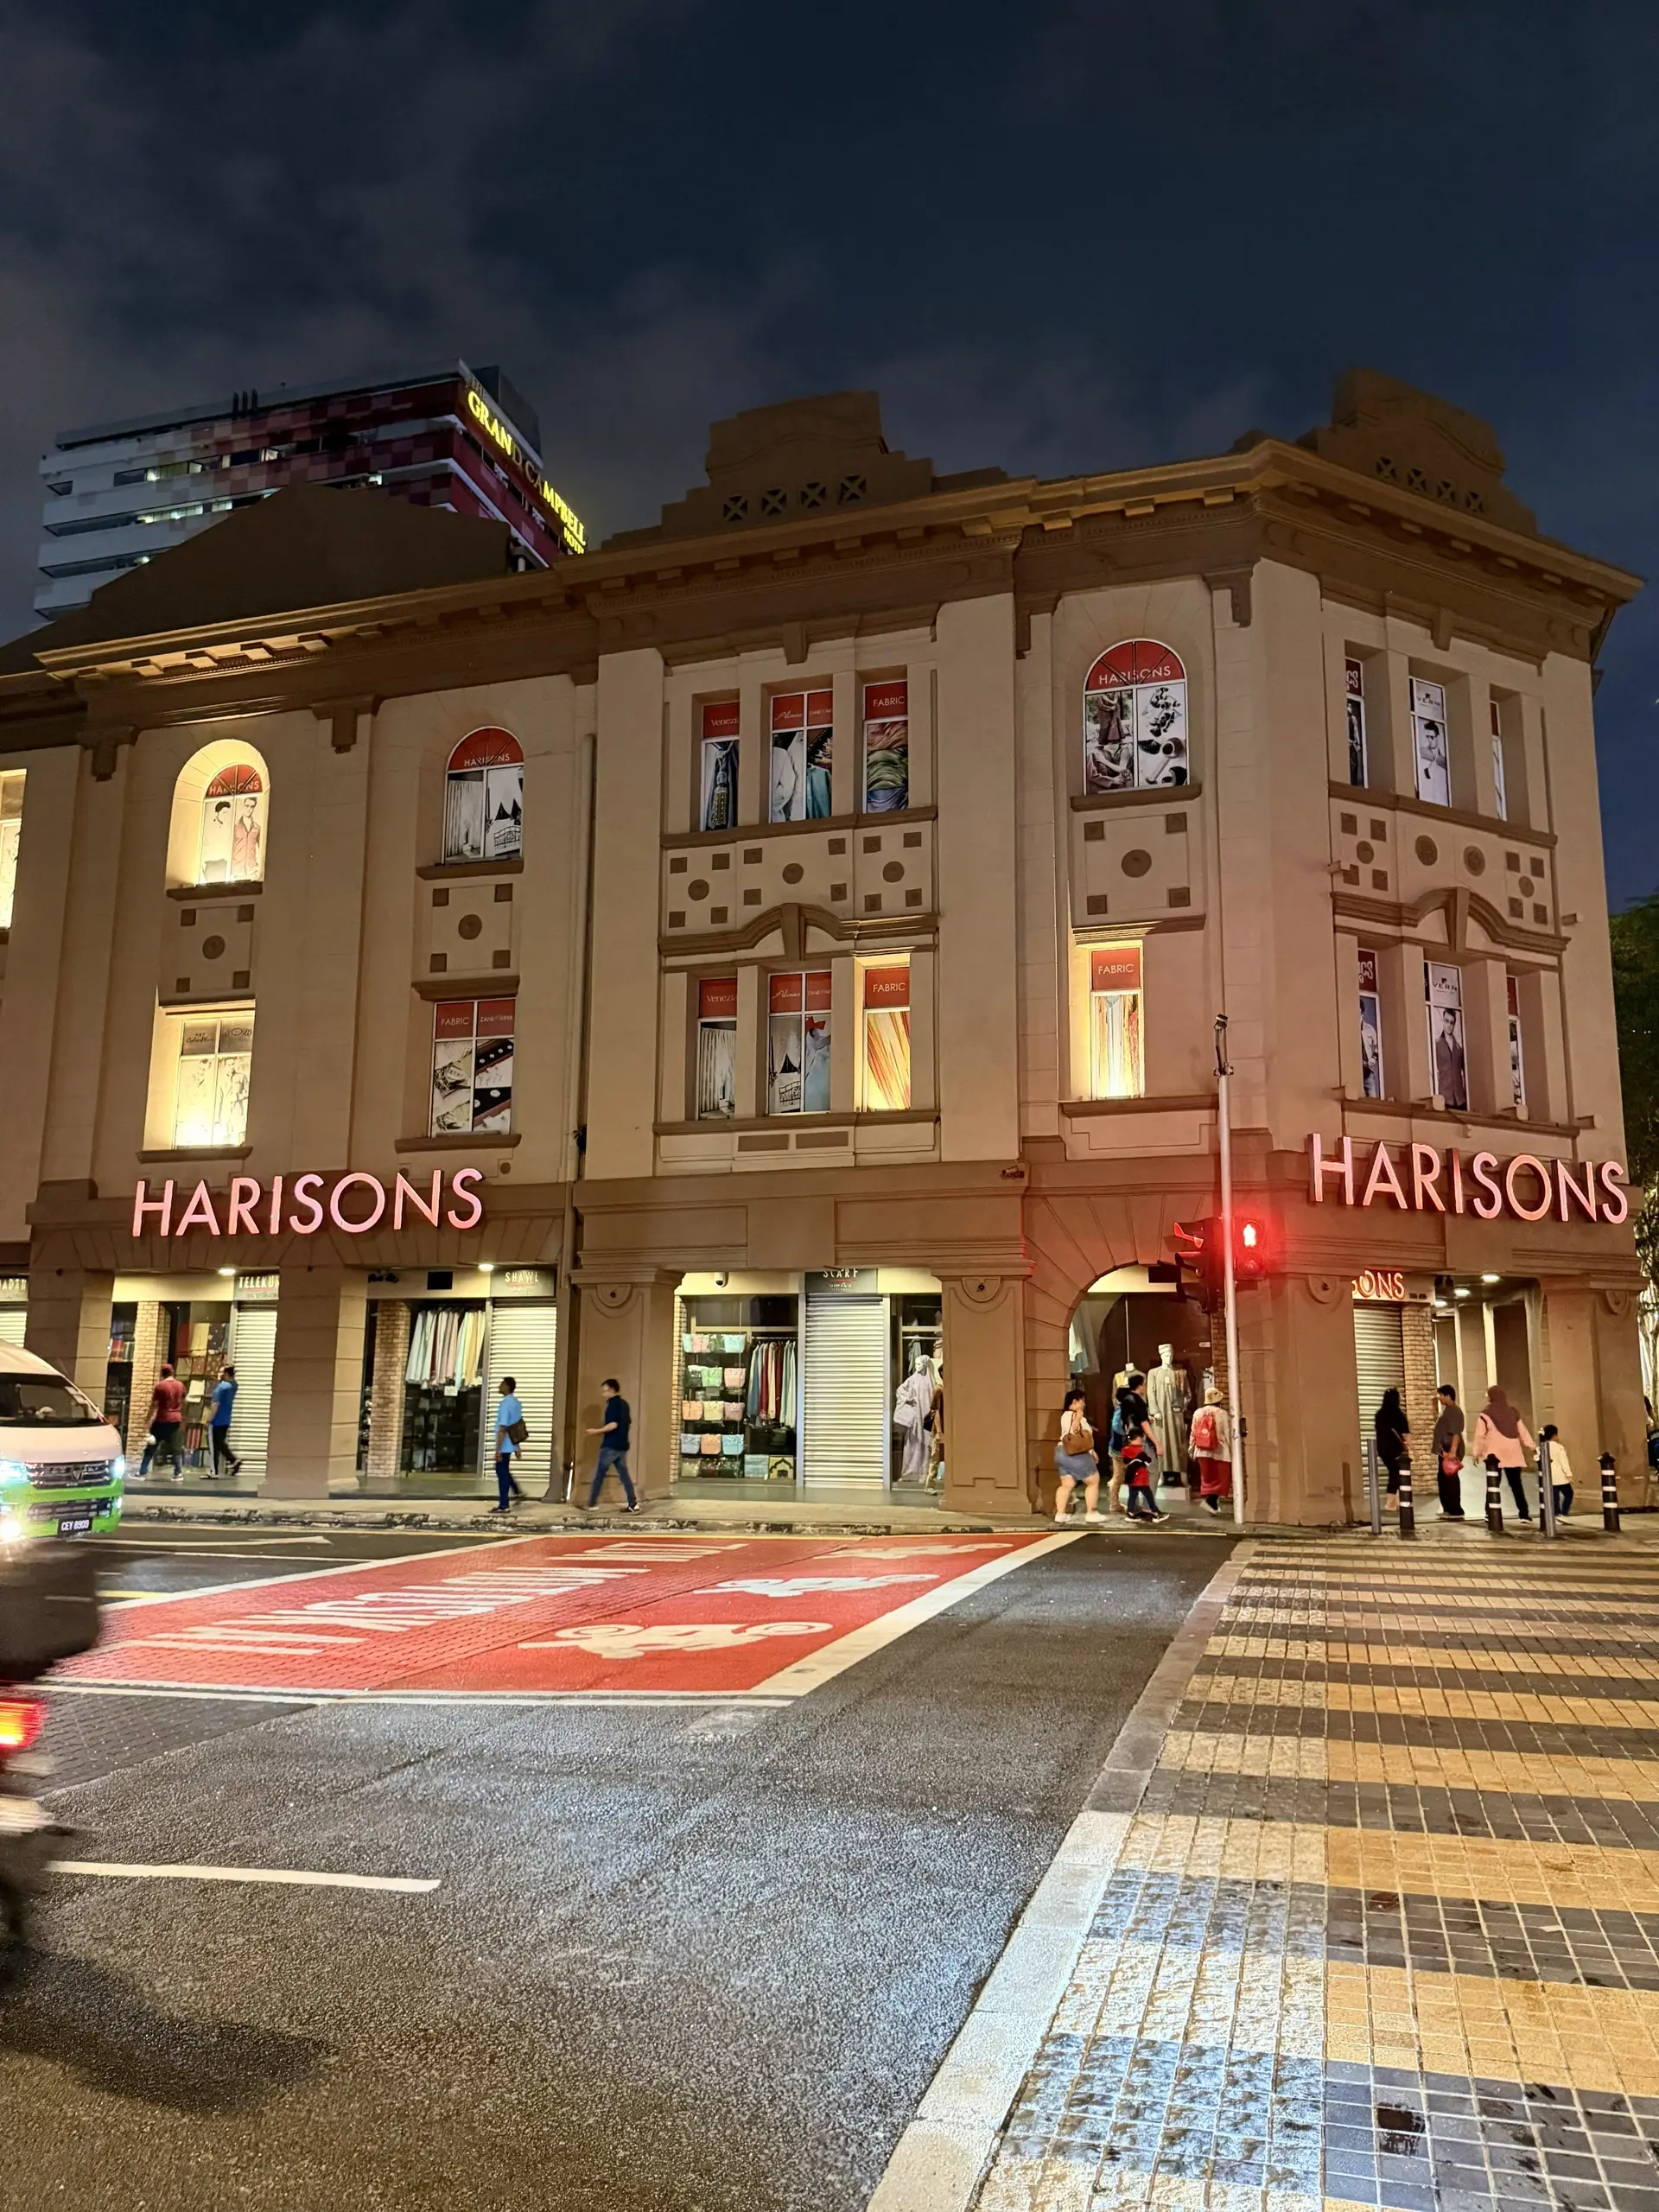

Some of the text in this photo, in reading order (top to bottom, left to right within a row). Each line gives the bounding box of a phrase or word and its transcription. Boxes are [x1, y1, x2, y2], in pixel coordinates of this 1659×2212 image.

[467, 391, 587, 546] GRAND CAMPBELL
[873, 696, 906, 708] FABRIC
[710, 717, 740, 727] Venezi
[1098, 963, 1135, 975] FABRIC
[873, 982, 906, 993] FABRIC
[441, 1016, 470, 1027] FABRIC
[1309, 1132, 1629, 1224] HARISONS
[131, 1167, 483, 1237] HARISONS
[505, 1271, 539, 1283] SHAWL
[0, 1278, 27, 1290] ADAH
